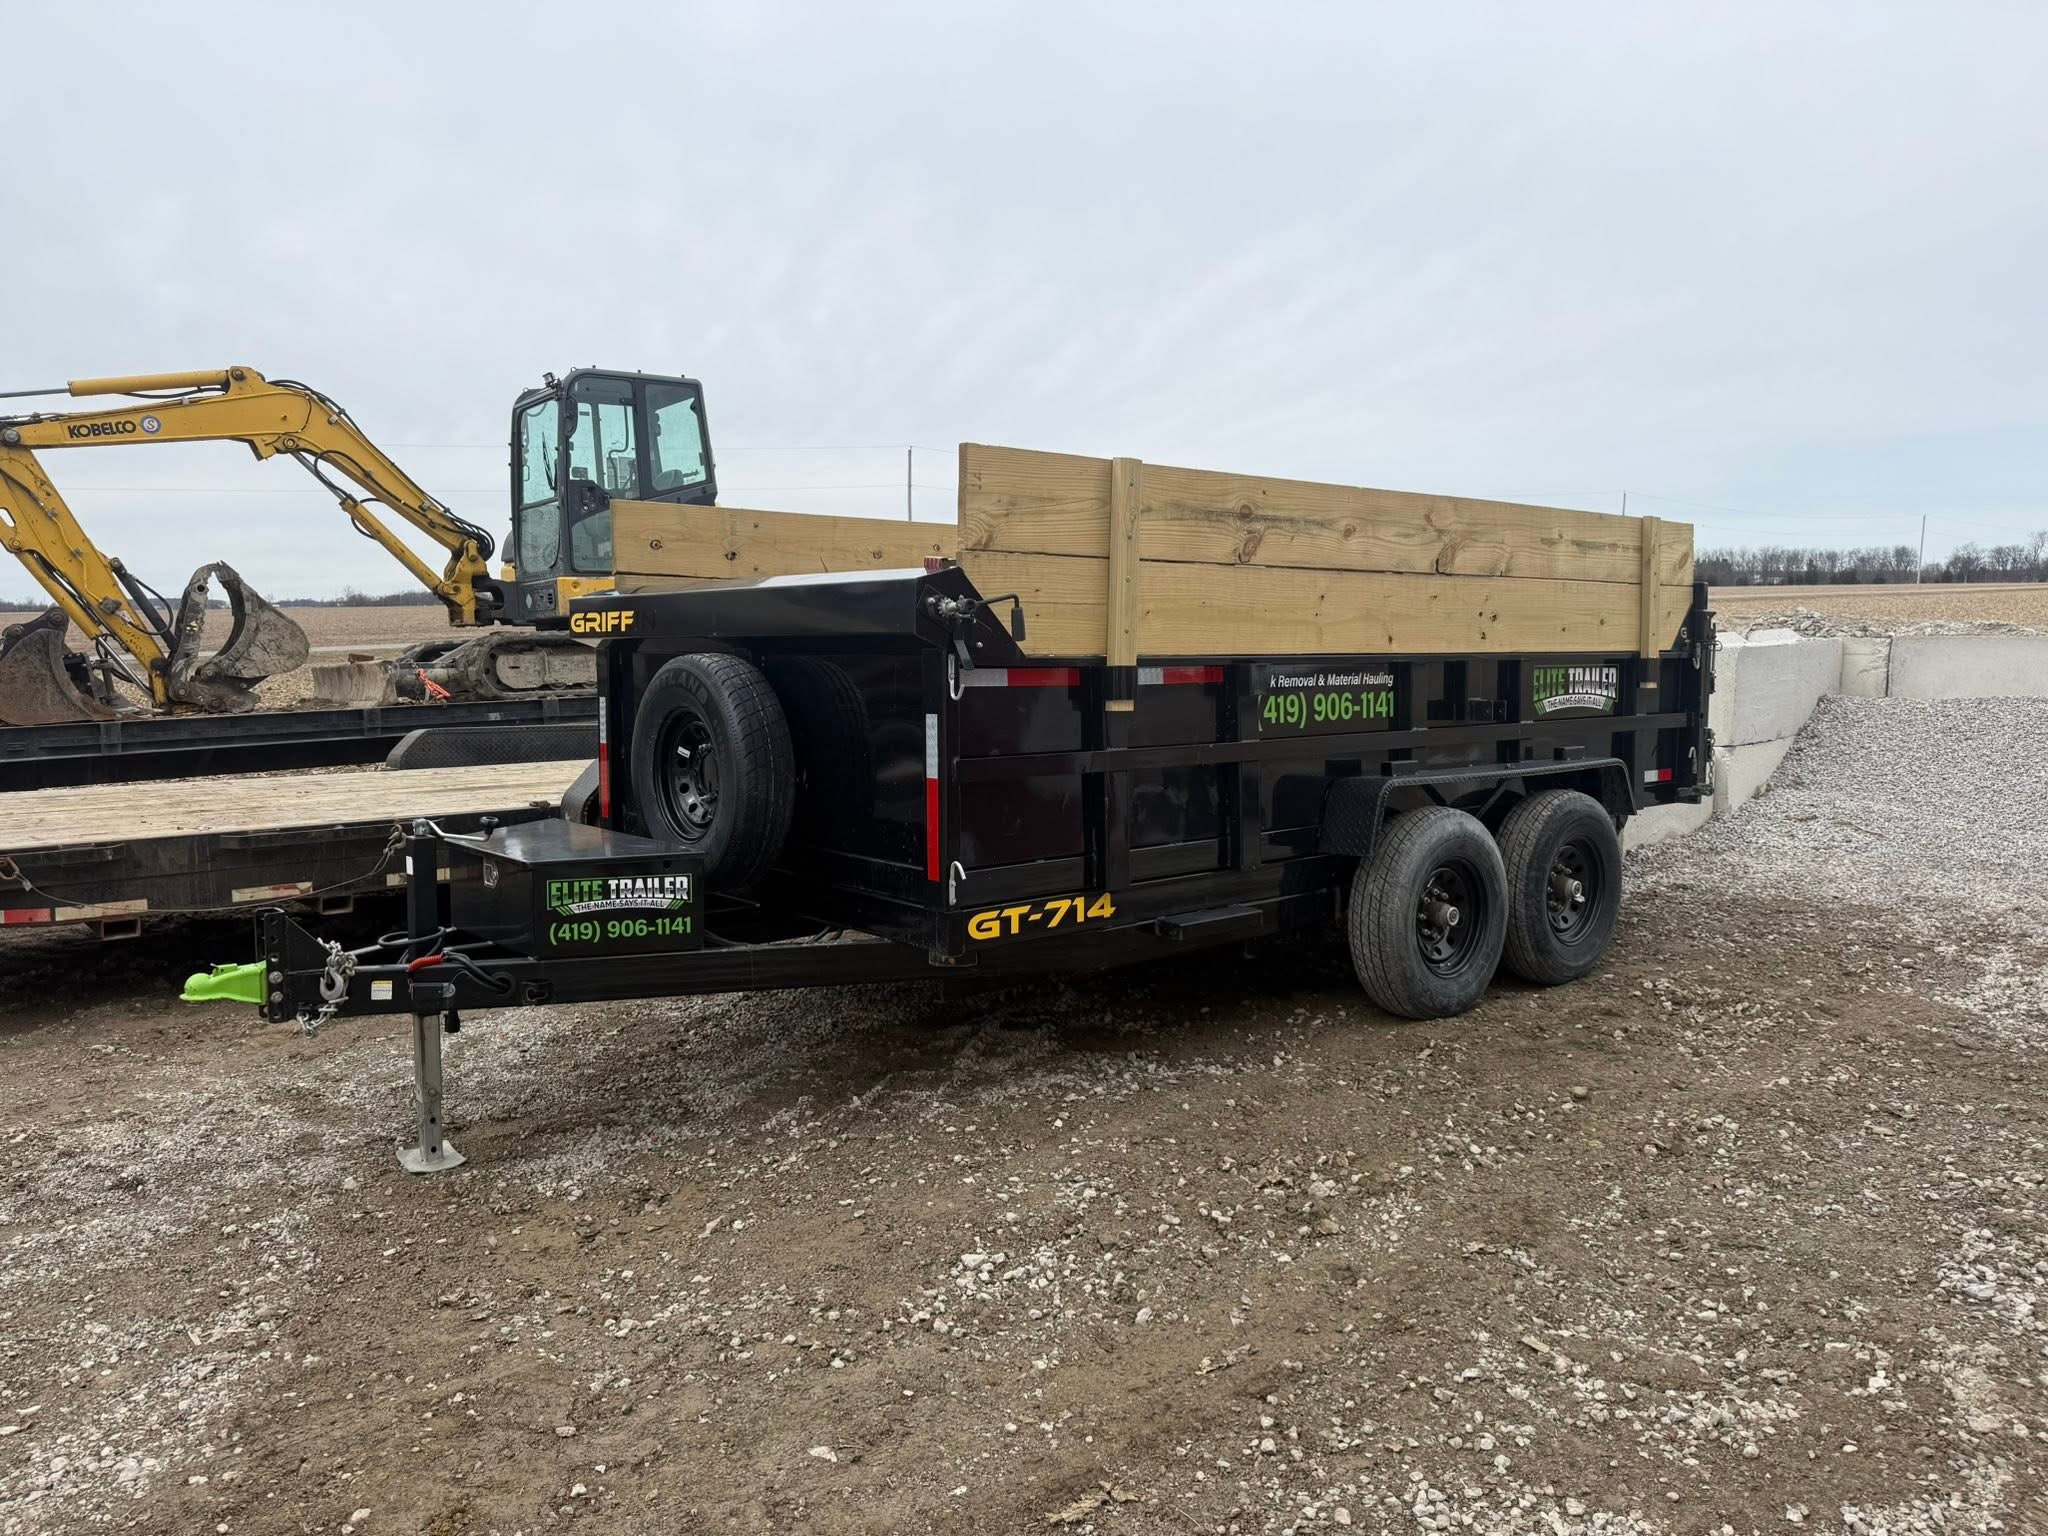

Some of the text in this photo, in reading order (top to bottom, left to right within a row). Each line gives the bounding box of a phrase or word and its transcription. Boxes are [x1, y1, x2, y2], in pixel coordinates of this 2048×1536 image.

[67, 420, 137, 439] KOBELCO
[1278, 673, 1317, 688] Removal
[1317, 674, 1325, 686] &
[1326, 673, 1361, 686] Material
[1362, 672, 1394, 687] Hauling
[1533, 667, 1617, 702] ELITE TRAILER
[1257, 690, 1395, 732] (419) 906-1141
[550, 876, 689, 907] ELITE TRAILER
[575, 898, 665, 912] THE NAME SAYS IT ALL
[549, 916, 692, 946] (419) 906-1141
[967, 892, 1117, 940] GT-714
